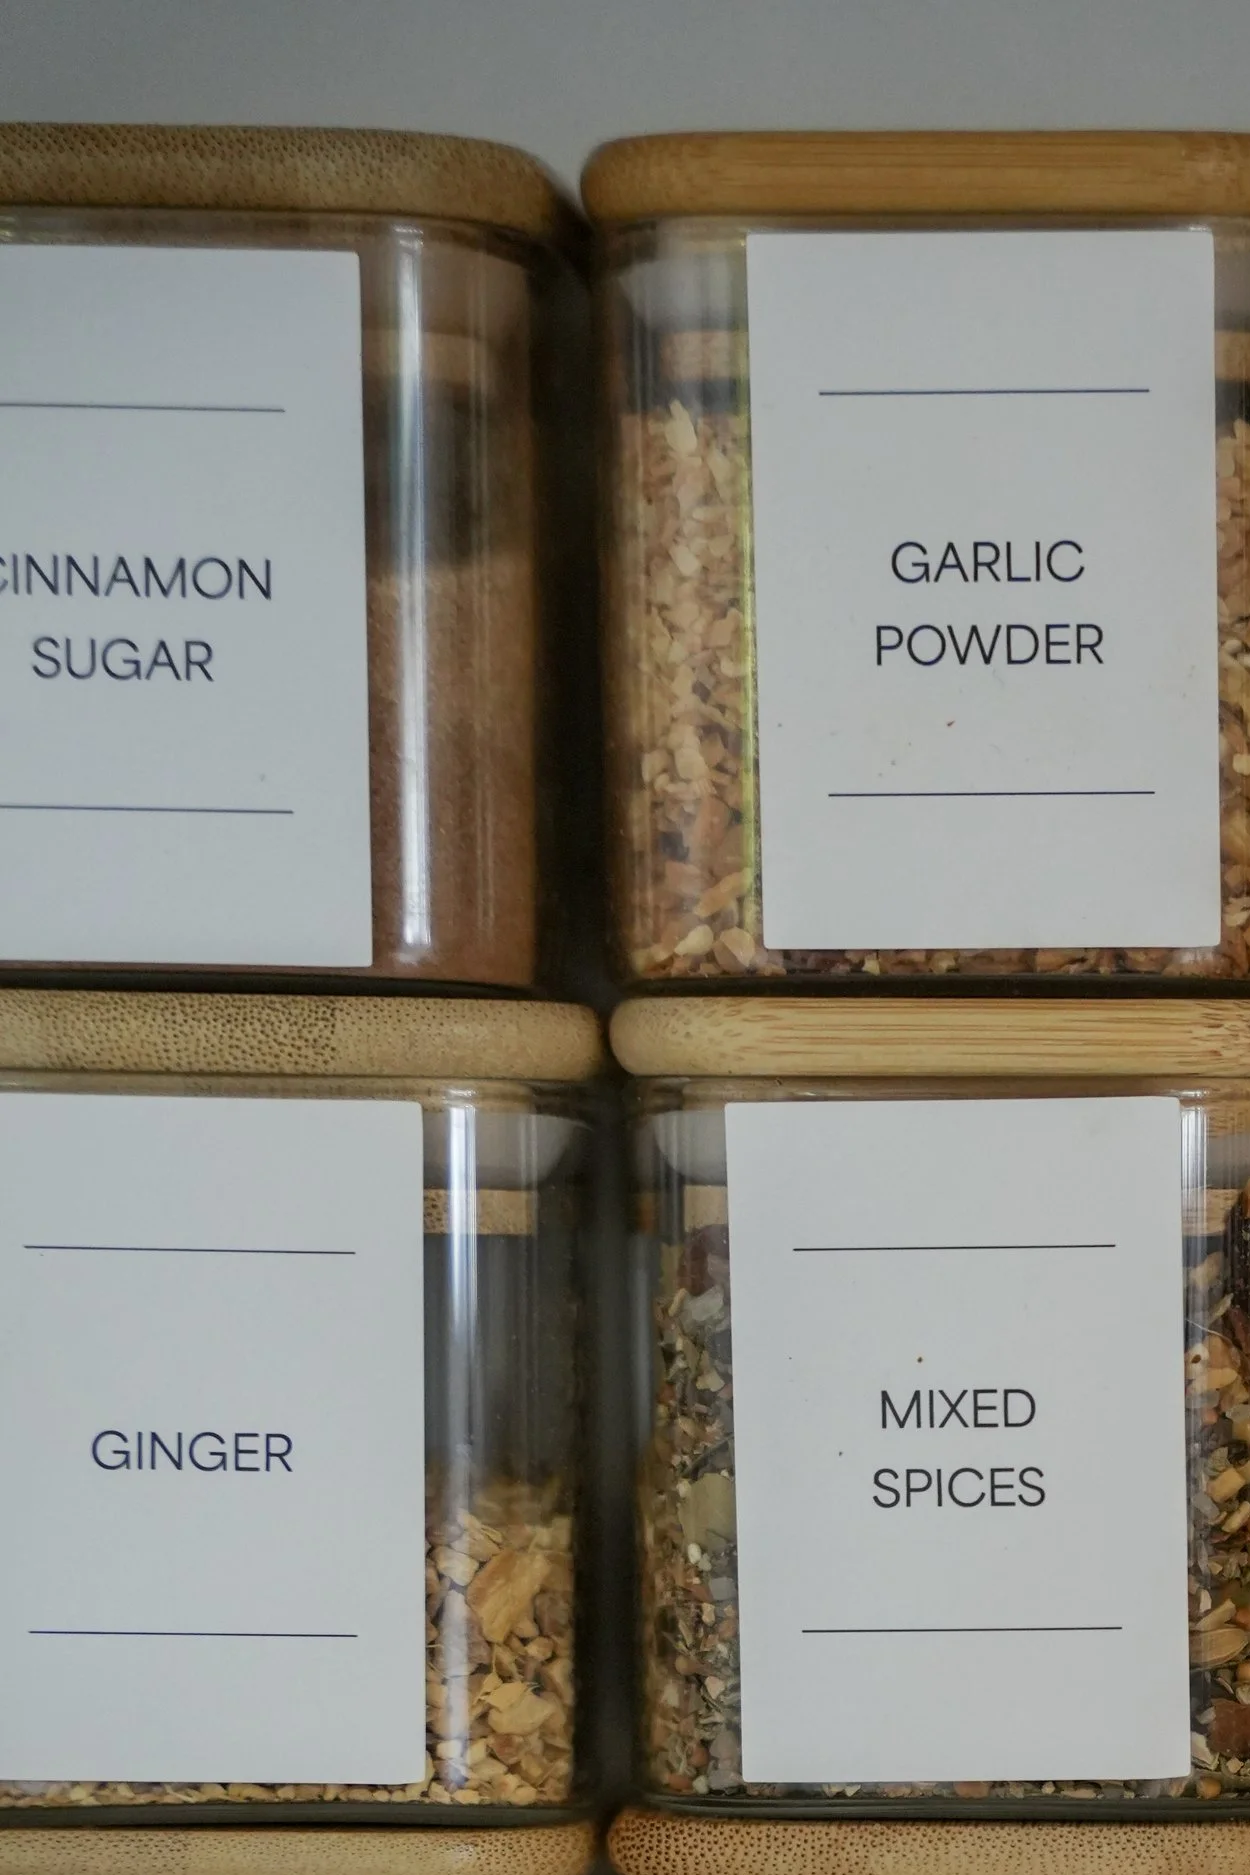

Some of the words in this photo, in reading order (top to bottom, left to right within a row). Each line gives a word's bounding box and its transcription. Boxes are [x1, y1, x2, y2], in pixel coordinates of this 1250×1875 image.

[0, 553, 272, 600] INNAMON
[891, 540, 1085, 584] GARLIC
[32, 636, 214, 682] SUGAR
[876, 624, 1104, 666] POWDER
[881, 1389, 1036, 1429] MIXED
[91, 1430, 293, 1472] GINGER
[873, 1466, 1046, 1508] SPICES
